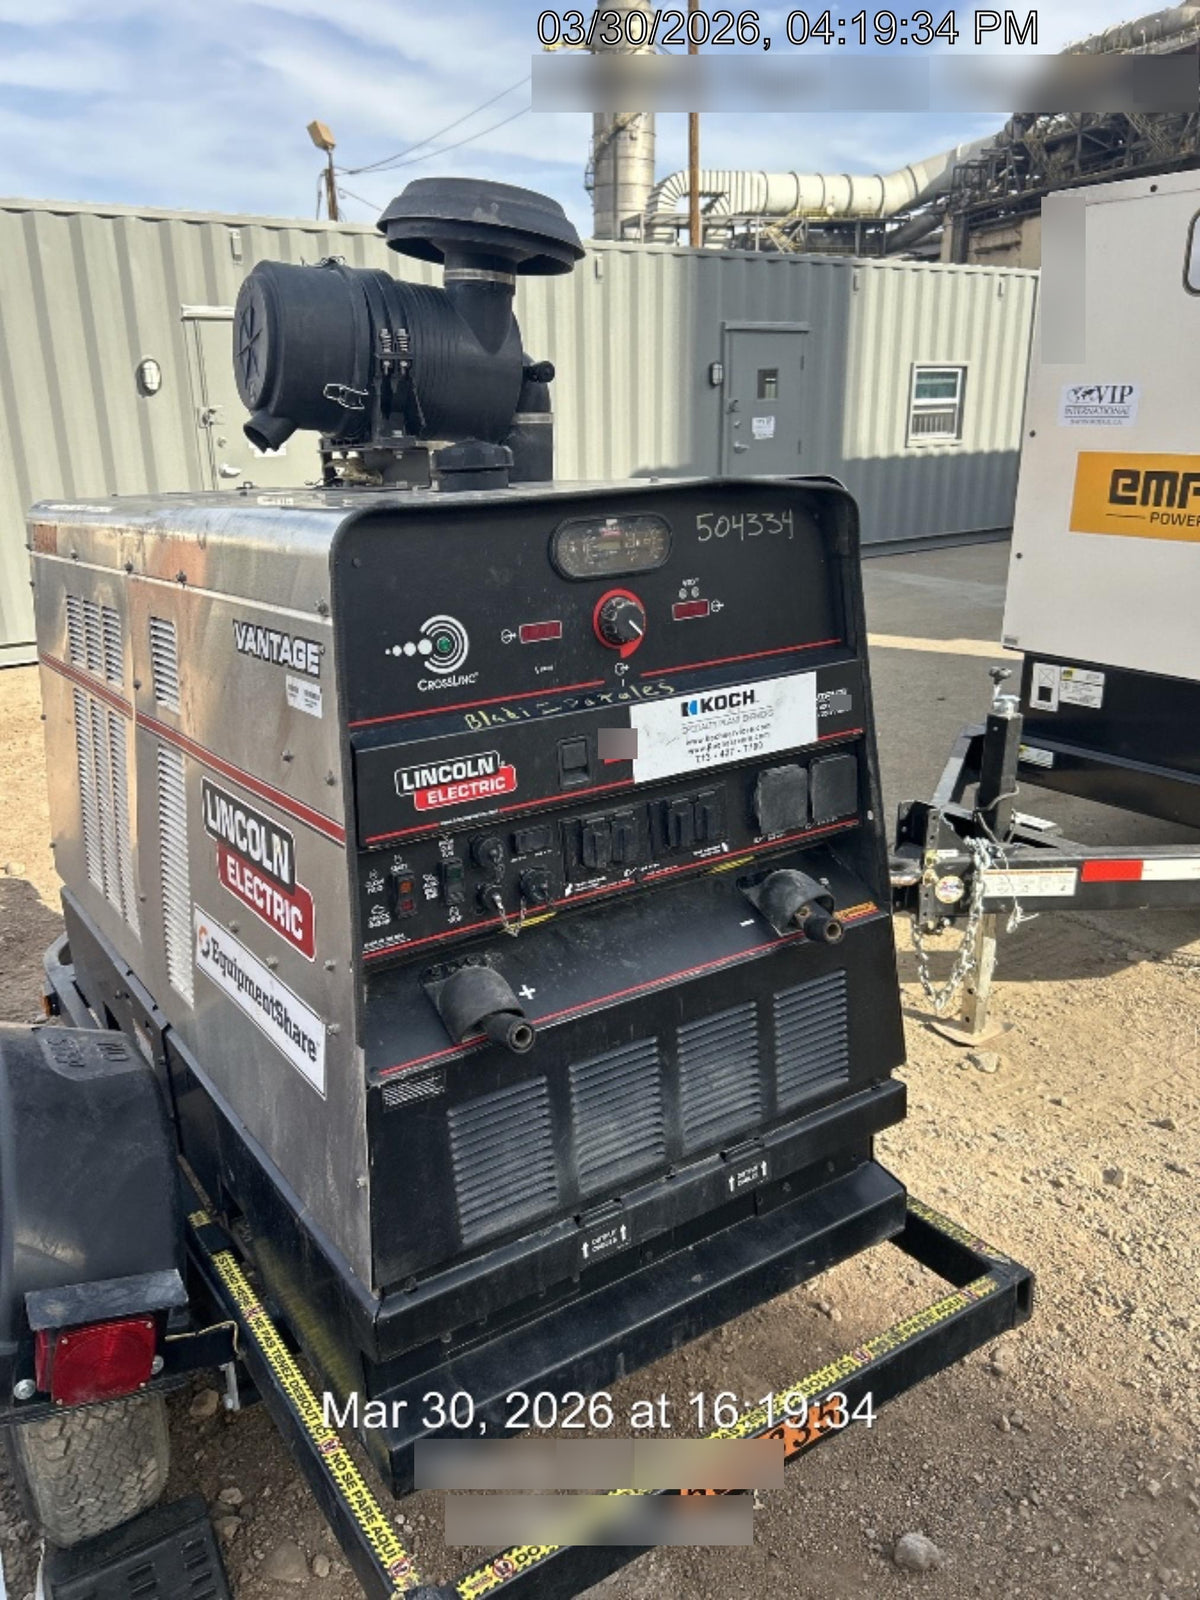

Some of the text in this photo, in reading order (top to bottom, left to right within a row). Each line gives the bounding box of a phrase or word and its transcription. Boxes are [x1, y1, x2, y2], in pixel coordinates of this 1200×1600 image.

[1095, 384, 1134, 404] VIP
[696, 509, 795, 542] 504334
[232, 618, 321, 678] VANTAGE
[700, 689, 755, 713] KOCH
[401, 755, 495, 791] LINCOLN
[427, 776, 507, 805] ELECTRIC
[205, 788, 290, 886] LINCOLN
[226, 853, 304, 942] ELECTRIC
[210, 935, 318, 1063] EquipmentShare
[329, 1452, 348, 1473] NO
[342, 1471, 358, 1490] SE
[351, 1489, 378, 1526] PARE
